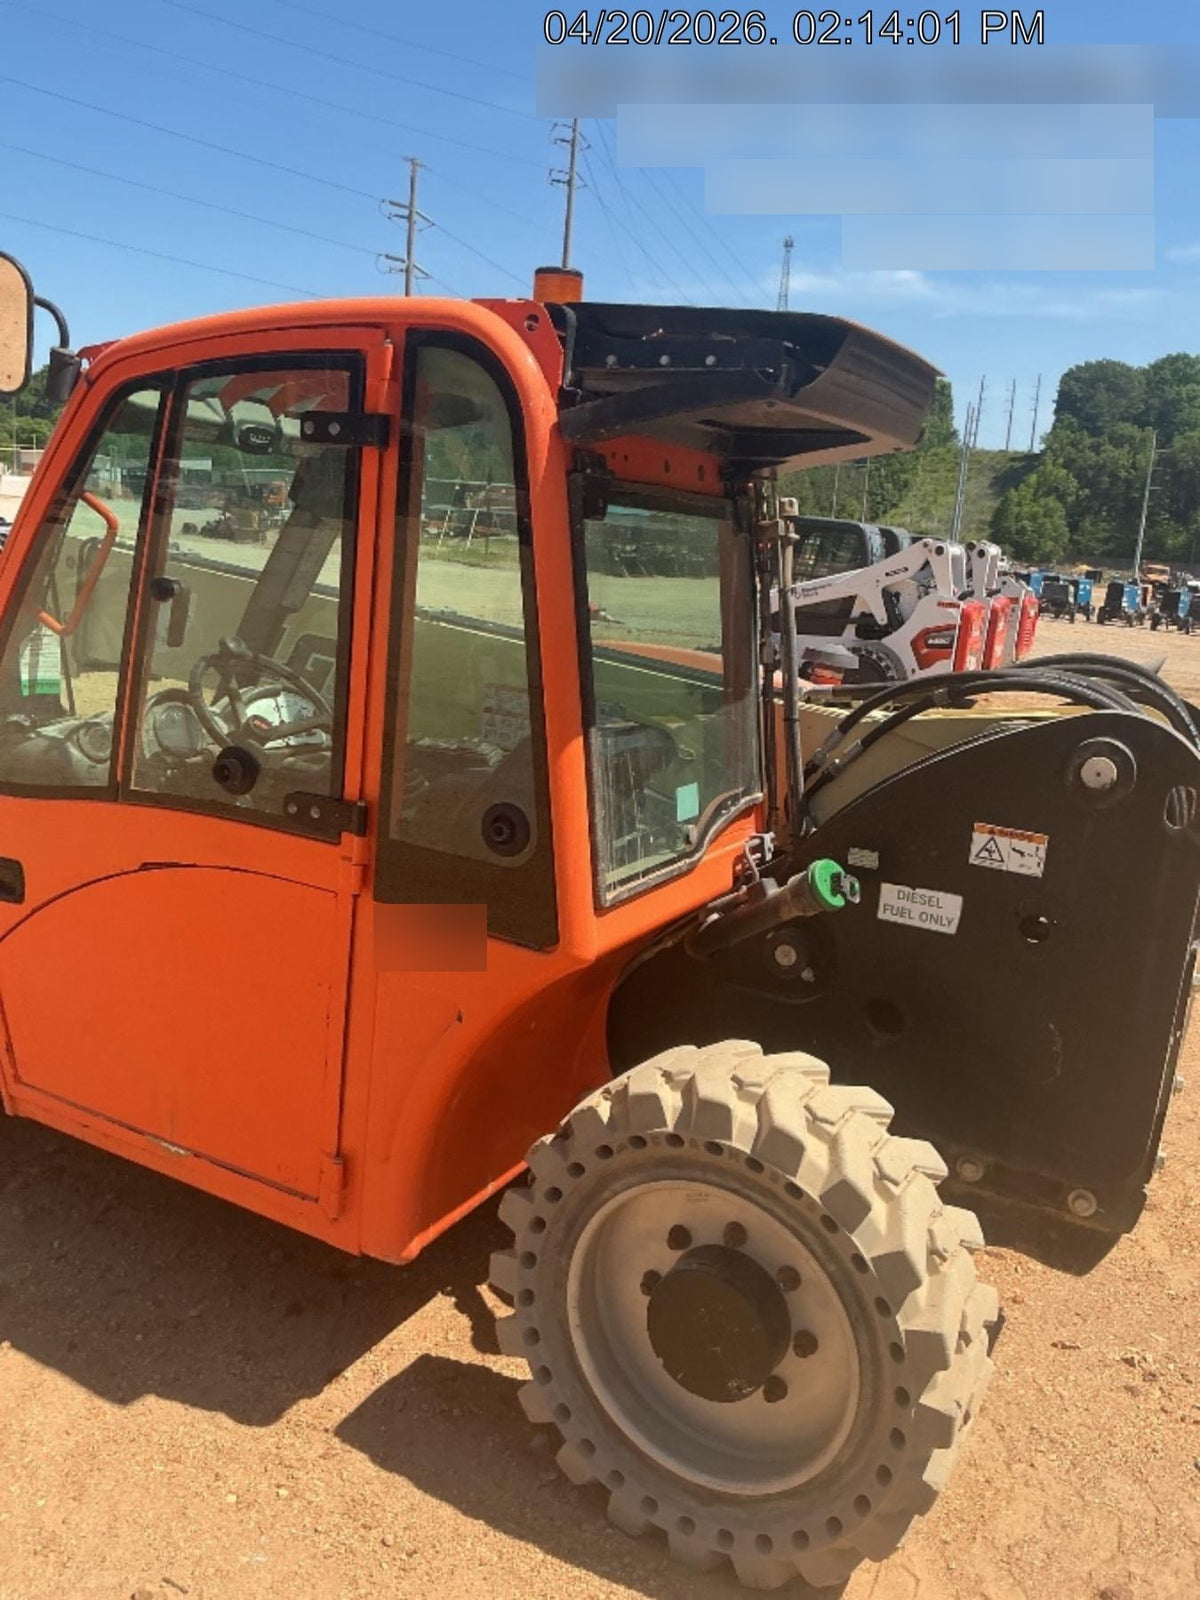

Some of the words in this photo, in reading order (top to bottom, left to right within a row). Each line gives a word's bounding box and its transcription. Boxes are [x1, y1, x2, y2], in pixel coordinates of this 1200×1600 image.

[897, 889, 943, 909] DIESEL
[883, 903, 914, 920] FUEL
[919, 911, 954, 928] ONLY
